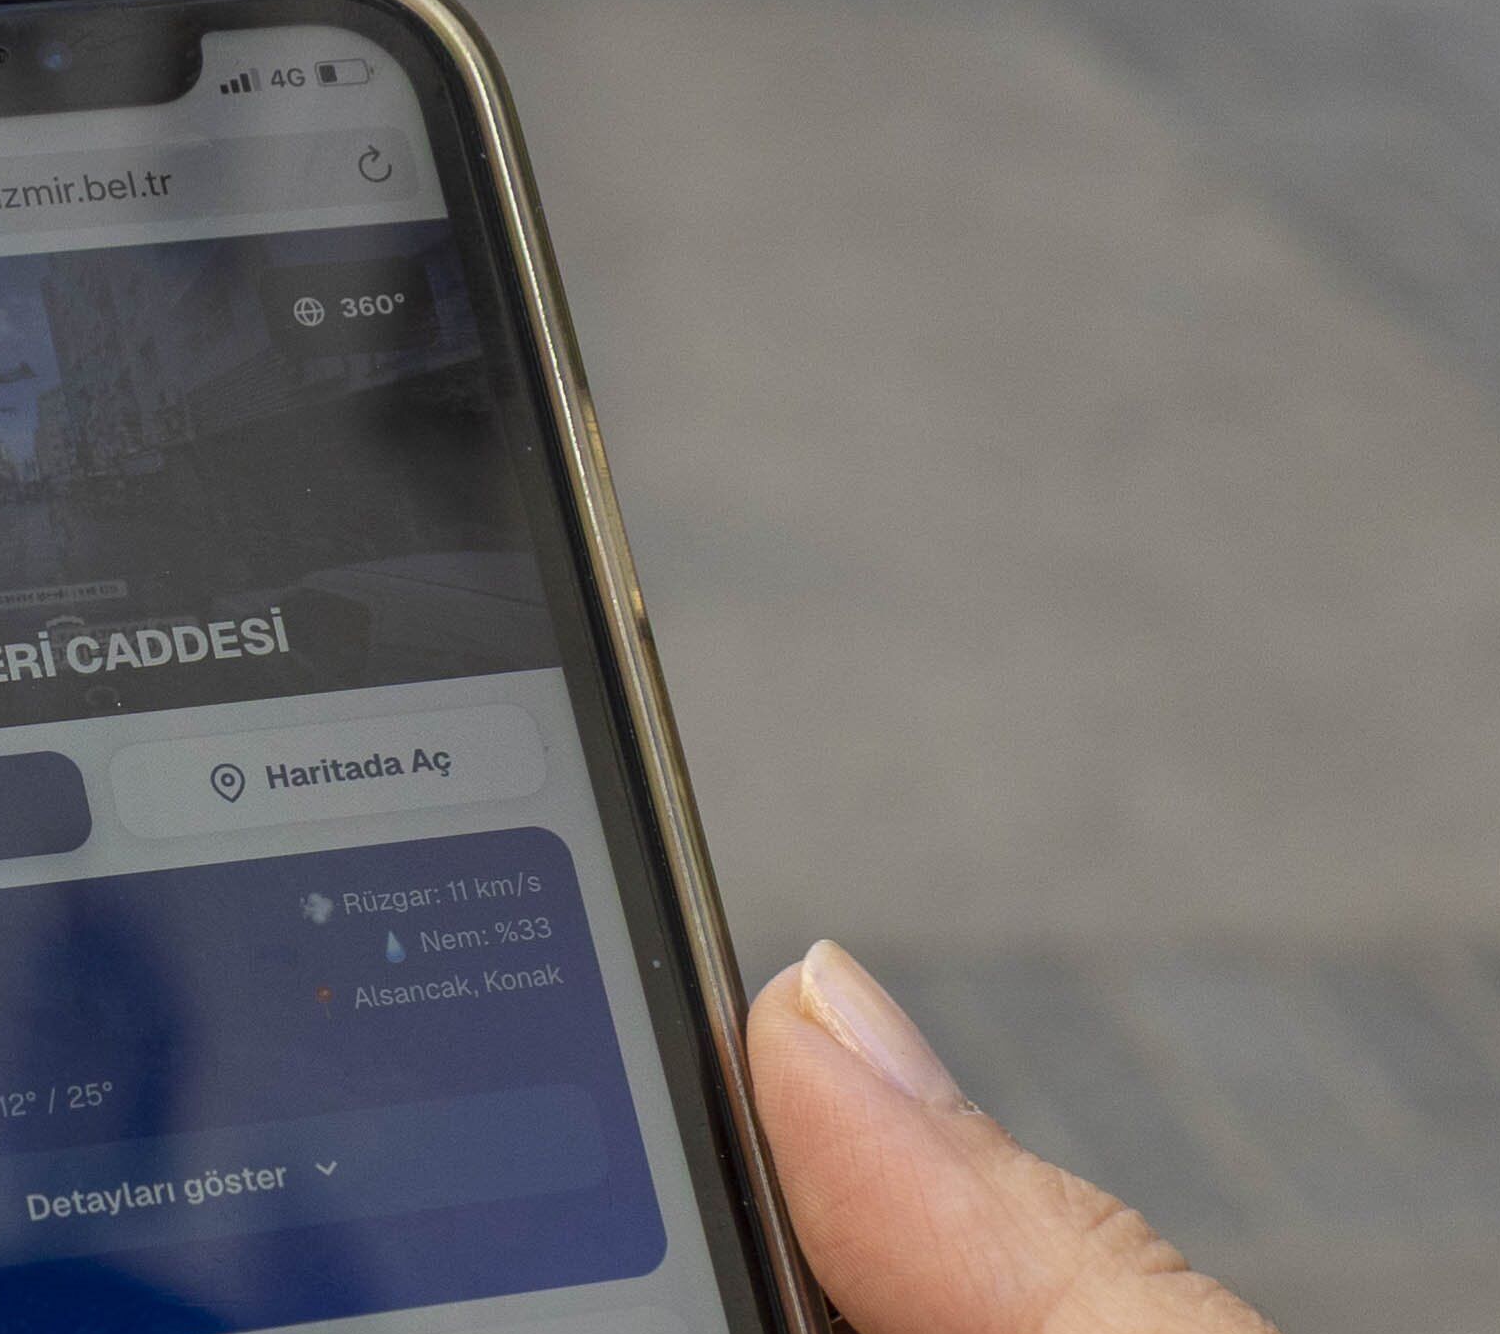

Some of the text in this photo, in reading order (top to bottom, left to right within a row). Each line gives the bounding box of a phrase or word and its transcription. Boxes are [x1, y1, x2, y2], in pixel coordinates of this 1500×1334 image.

[270, 68, 306, 90] 4G
[341, 293, 405, 319] 360°
[66, 607, 290, 675] CADDESİ
[266, 748, 452, 789] Haritada Aç
[343, 872, 542, 915] Rüzgar: 11 km/s
[420, 917, 553, 953] Nem: %33
[354, 964, 564, 1010] Alsancak, Konak
[67, 1082, 114, 1110] 25°
[26, 1165, 287, 1222] Detayları göster
